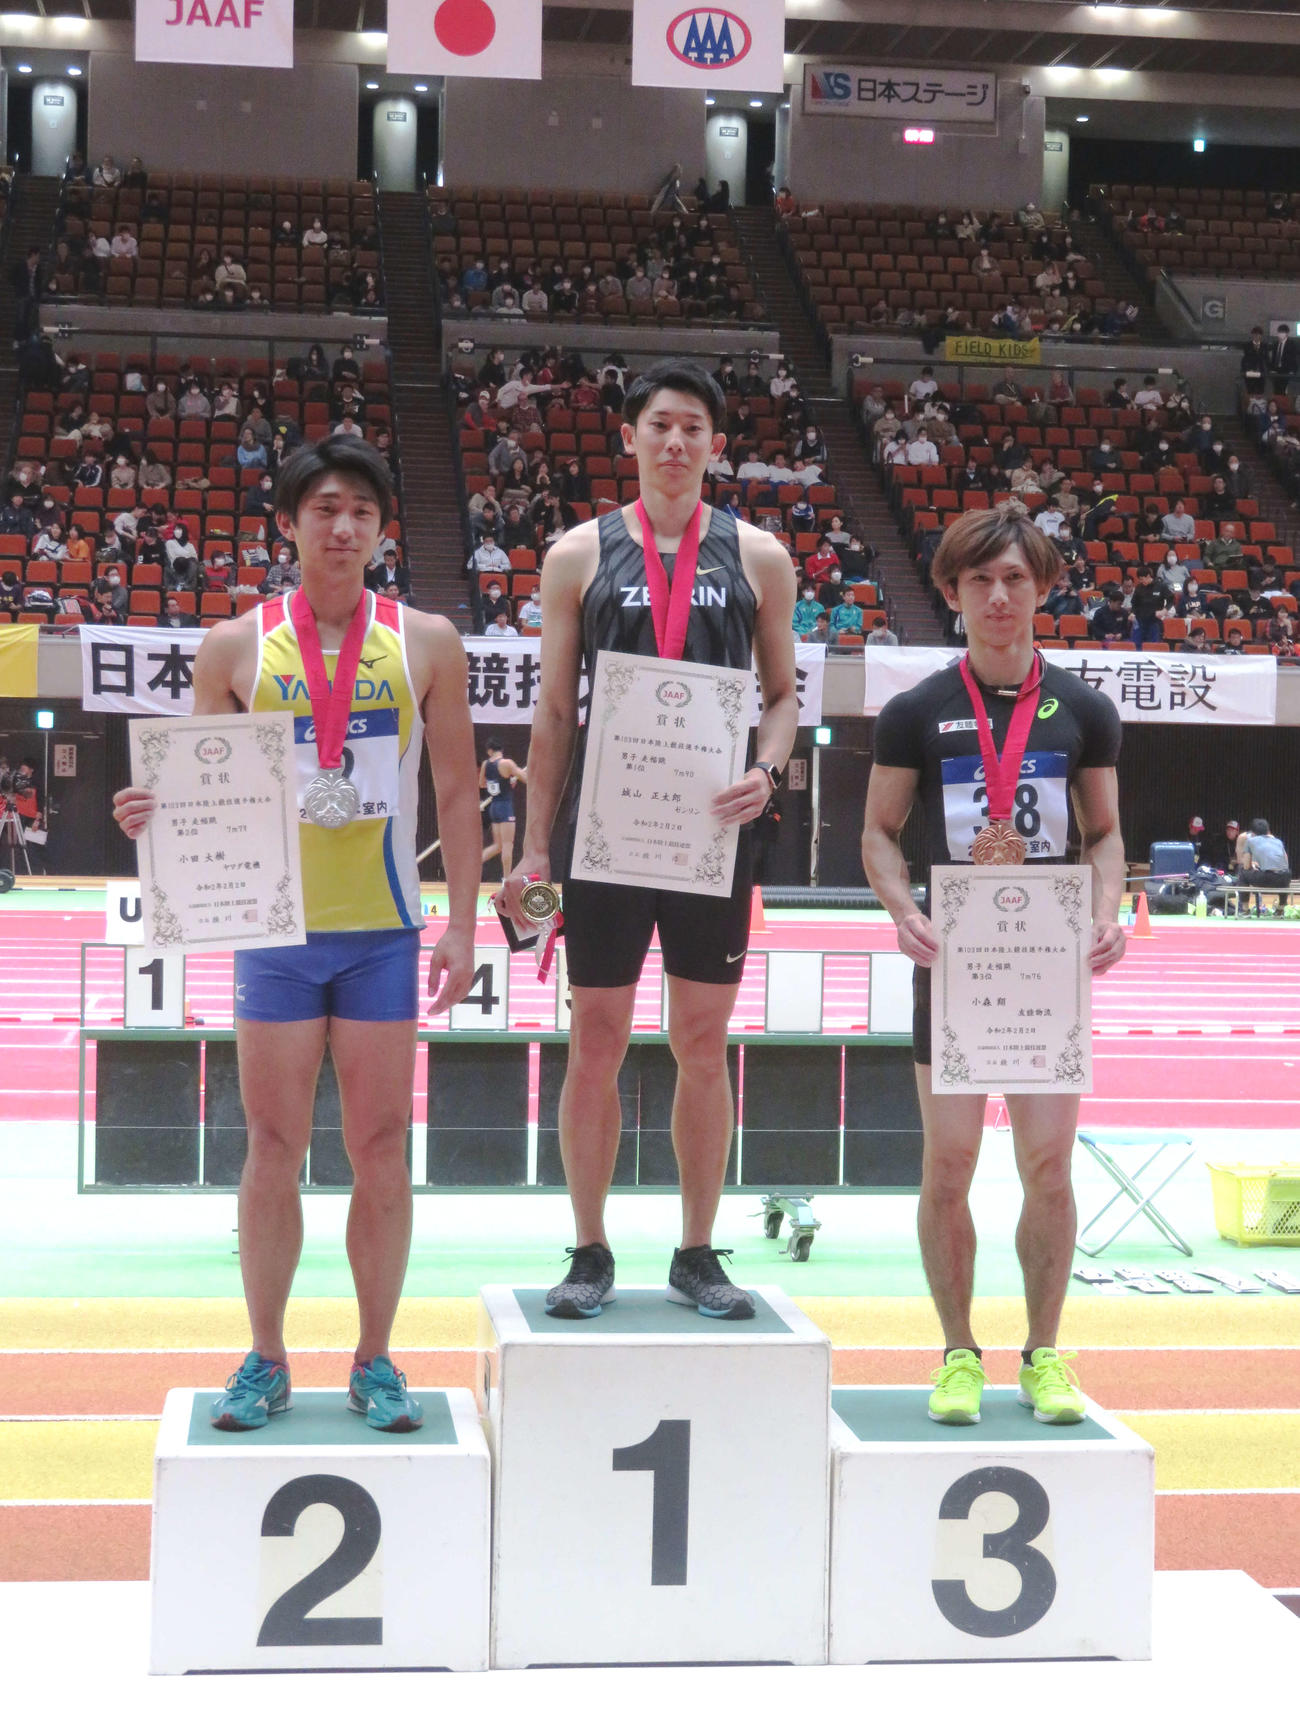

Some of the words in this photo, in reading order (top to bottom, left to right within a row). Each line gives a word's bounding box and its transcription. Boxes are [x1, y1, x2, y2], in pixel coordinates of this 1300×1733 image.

[165, 0, 265, 29] JAAF
[857, 78, 989, 107] 日本ステージ
[1204, 300, 1224, 319] G
[954, 340, 992, 356] FIELD
[620, 586, 726, 608] ZERIN
[91, 642, 197, 700] 日本
[272, 675, 395, 701] YADA
[663, 690, 685, 700] JAAF
[656, 713, 686, 728] 賞状
[202, 747, 225, 756] JAAF
[200, 772, 231, 785] 賞状
[179, 854, 199, 864] 小田
[1000, 896, 1022, 904] JAAF
[997, 920, 1027, 933] 賞状
[138, 958, 164, 1011] 1
[457, 963, 500, 1015] 4
[972, 997, 992, 1007] 小森
[612, 1419, 691, 1586] 1
[256, 1473, 383, 1647] 2
[931, 1466, 1057, 1638] 3
